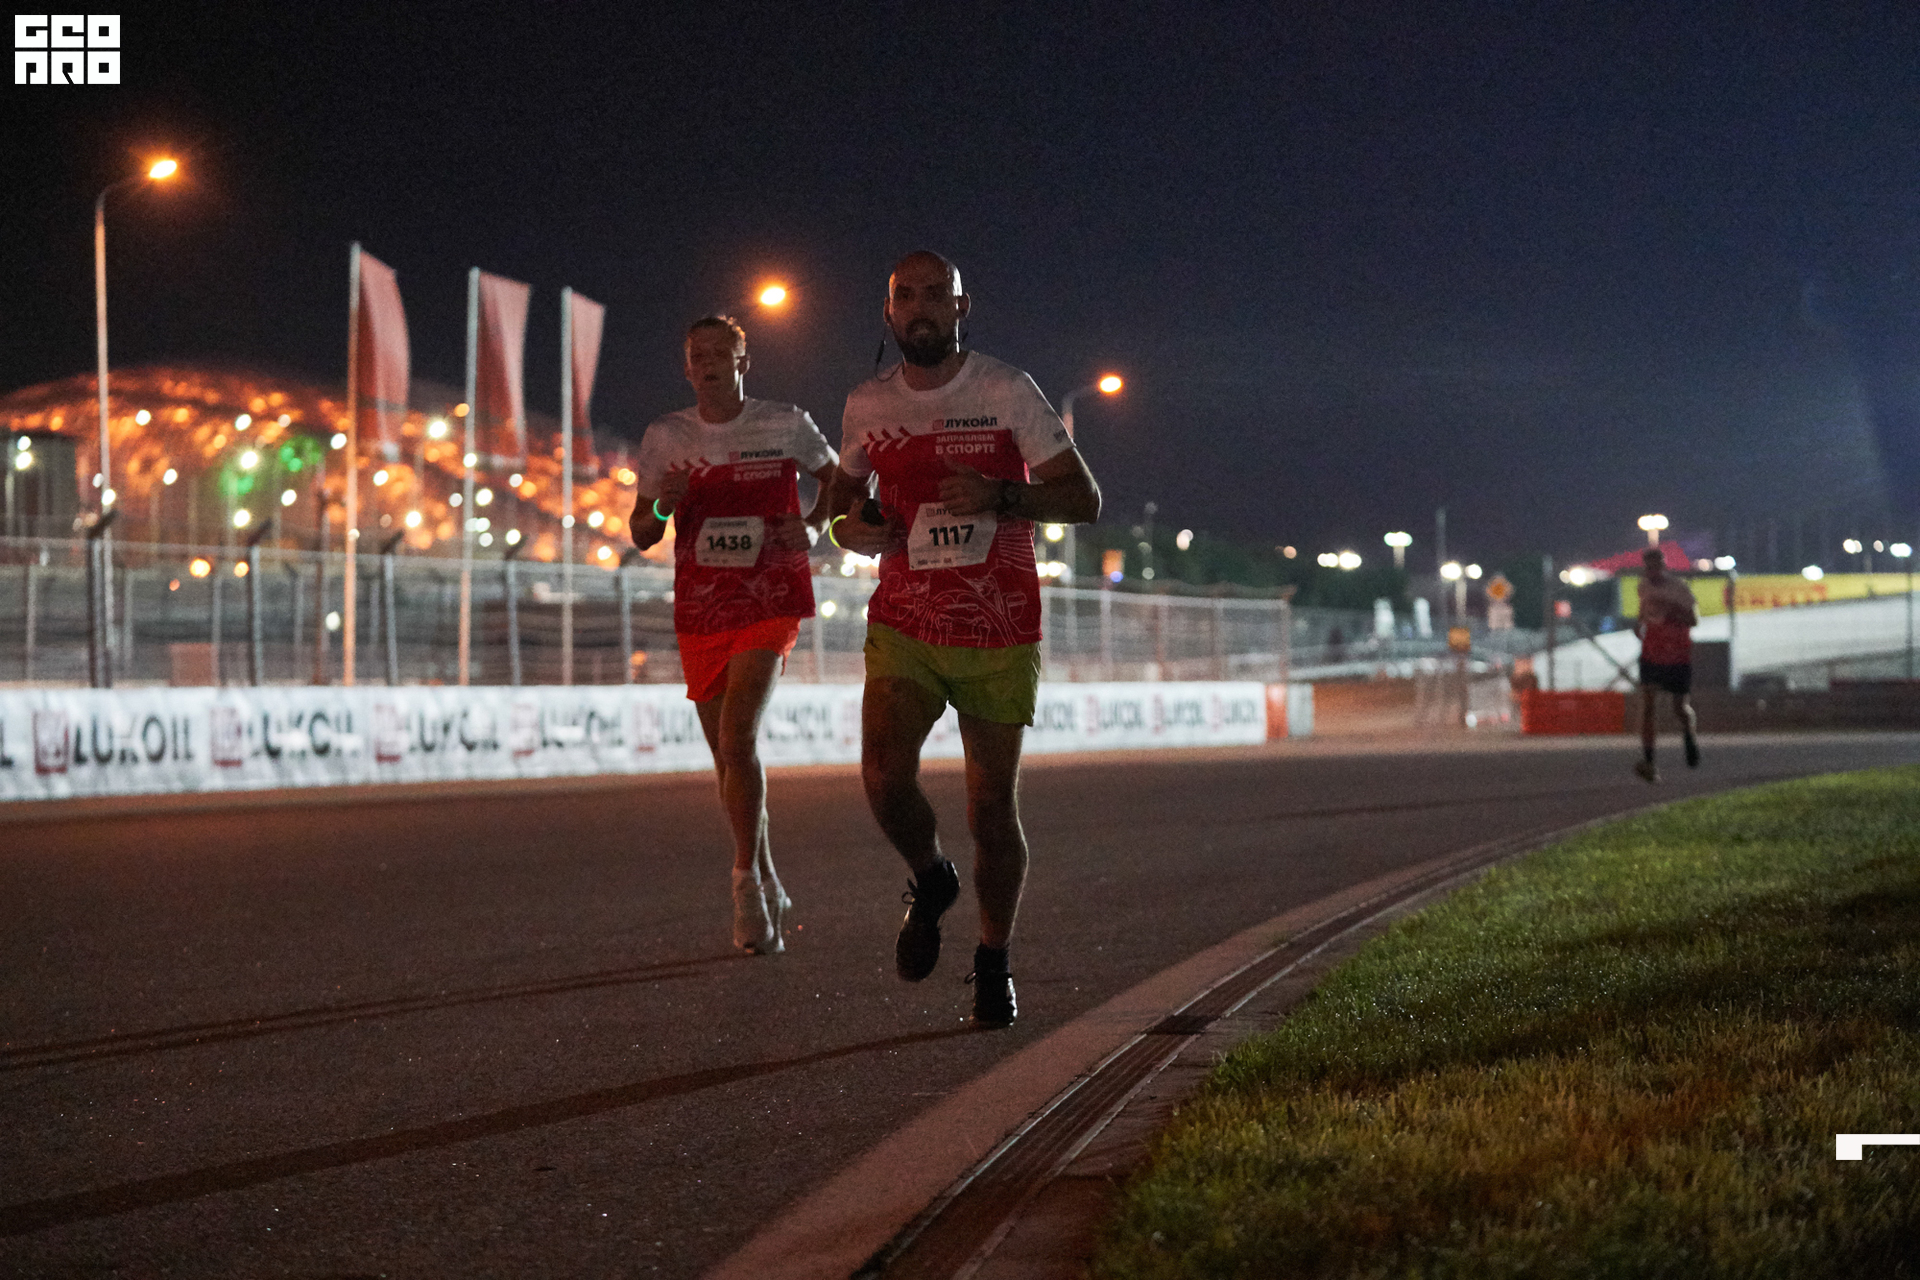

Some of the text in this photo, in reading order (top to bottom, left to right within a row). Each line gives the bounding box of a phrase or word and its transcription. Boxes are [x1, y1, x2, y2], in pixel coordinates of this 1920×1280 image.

[945, 415, 998, 429] ЛУКОЙЛ
[936, 434, 995, 444] ЗАПРАВЛЯЕМ
[935, 443, 996, 455] В СПОРТЕ
[928, 524, 974, 547] 1117
[707, 535, 752, 551] 1438
